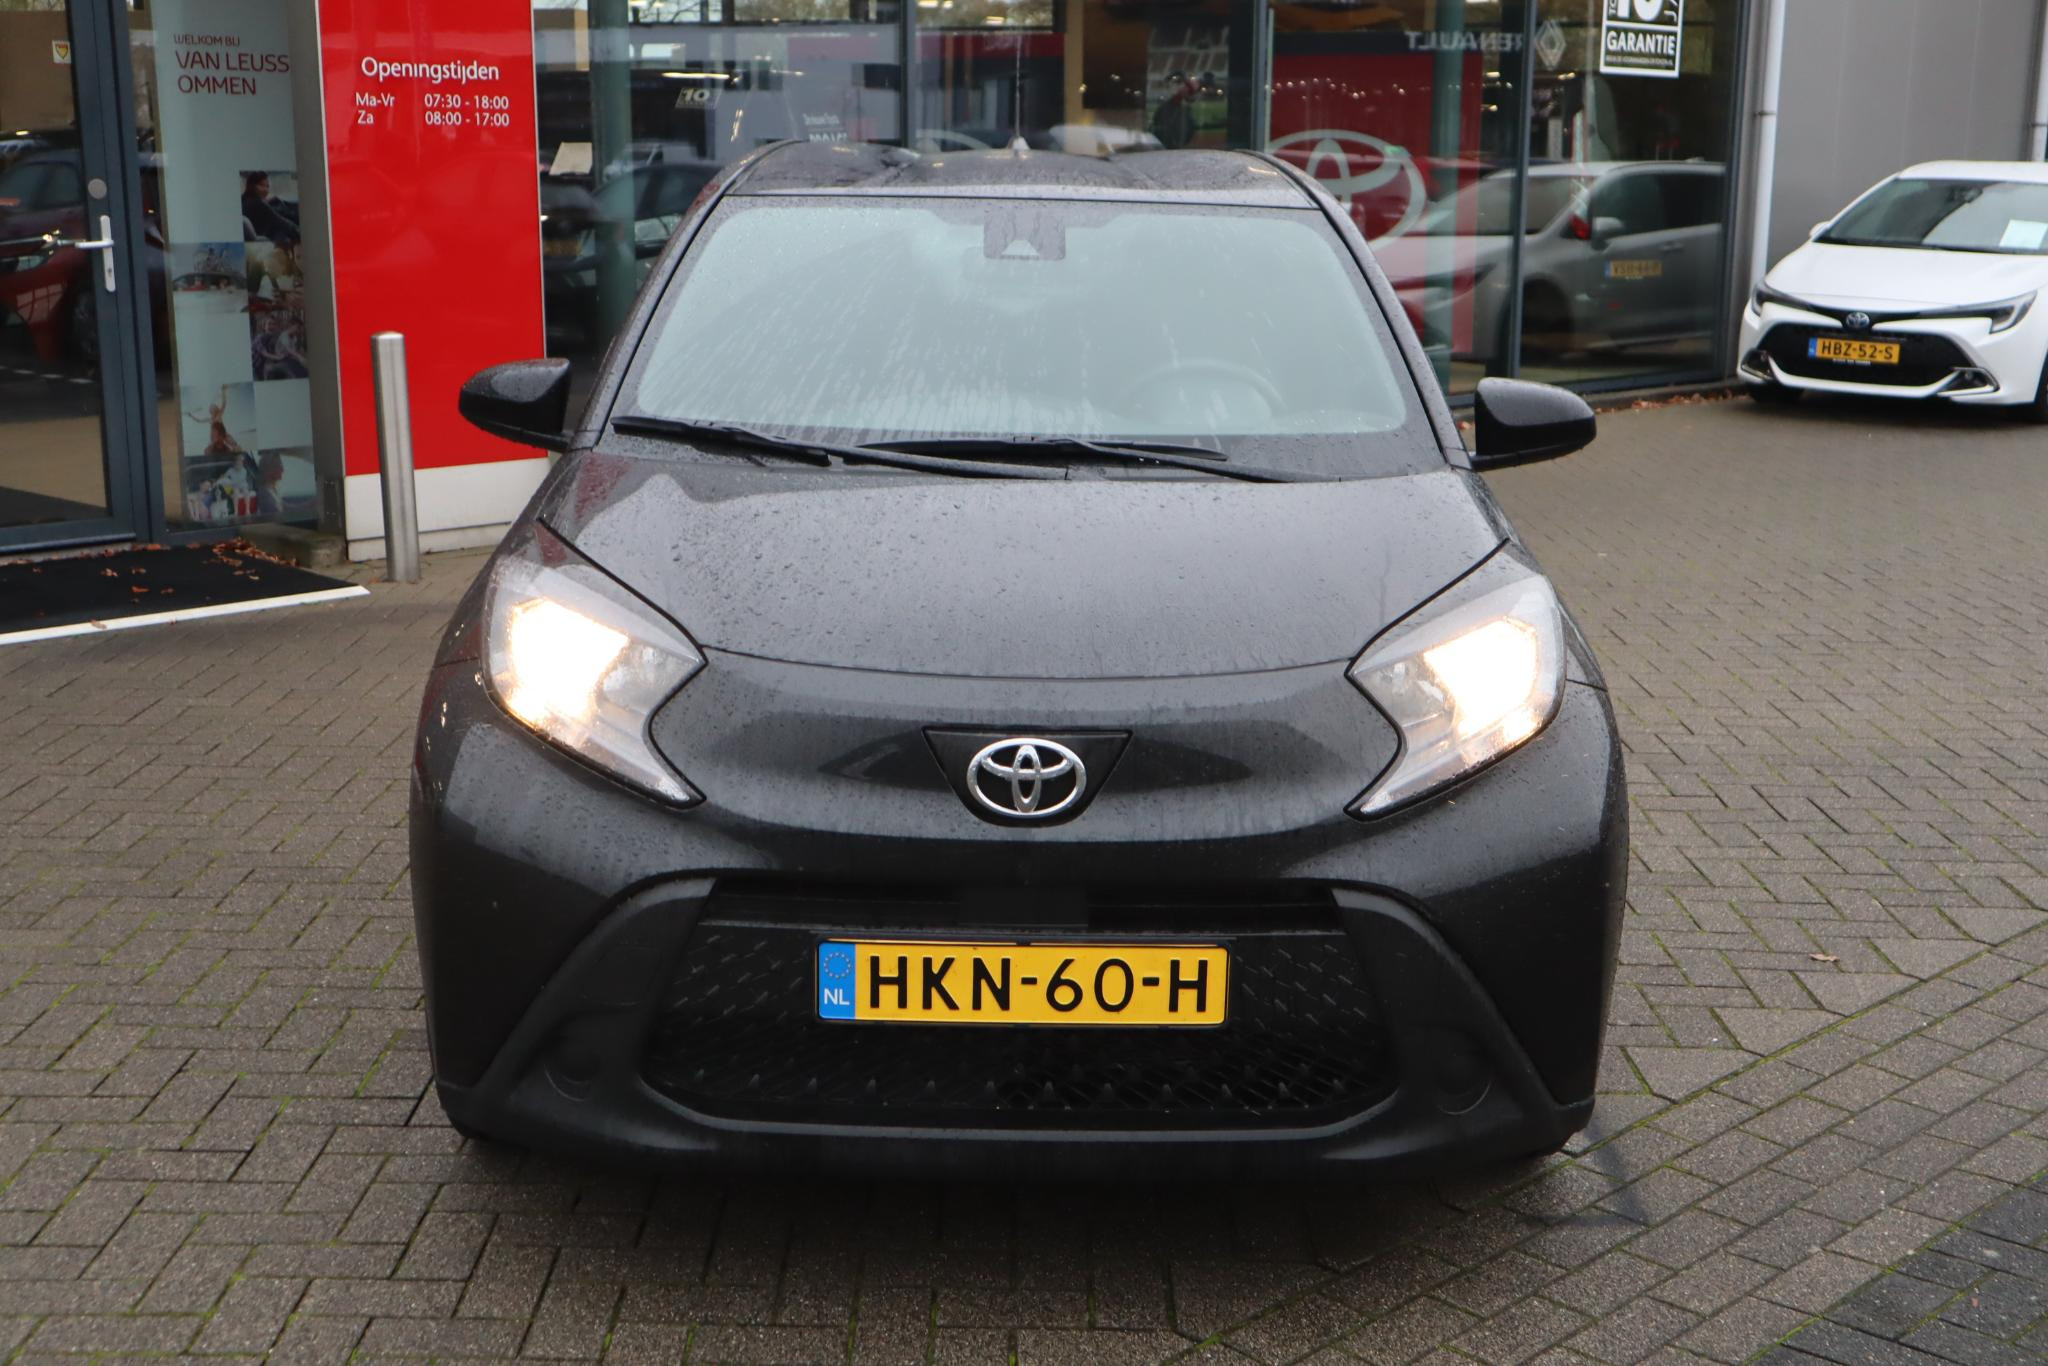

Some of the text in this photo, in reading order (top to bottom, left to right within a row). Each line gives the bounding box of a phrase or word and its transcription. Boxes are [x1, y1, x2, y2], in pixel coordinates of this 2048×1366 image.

[173, 33, 223, 46] WELKOM
[1606, 30, 1676, 56] GARANTIE
[175, 50, 221, 70] VAN
[360, 56, 500, 85] Openingstijden
[177, 74, 258, 95] OMMEN
[355, 92, 396, 107] Ma-Vr
[424, 93, 462, 108] 07:30
[473, 95, 510, 110] 18:00
[357, 109, 375, 125] Za
[425, 111, 462, 125] 08:00
[474, 112, 510, 127] 17:00
[1821, 341, 1893, 360] HBZ-52-S
[823, 955, 1209, 1013] NL HKN-60-H
